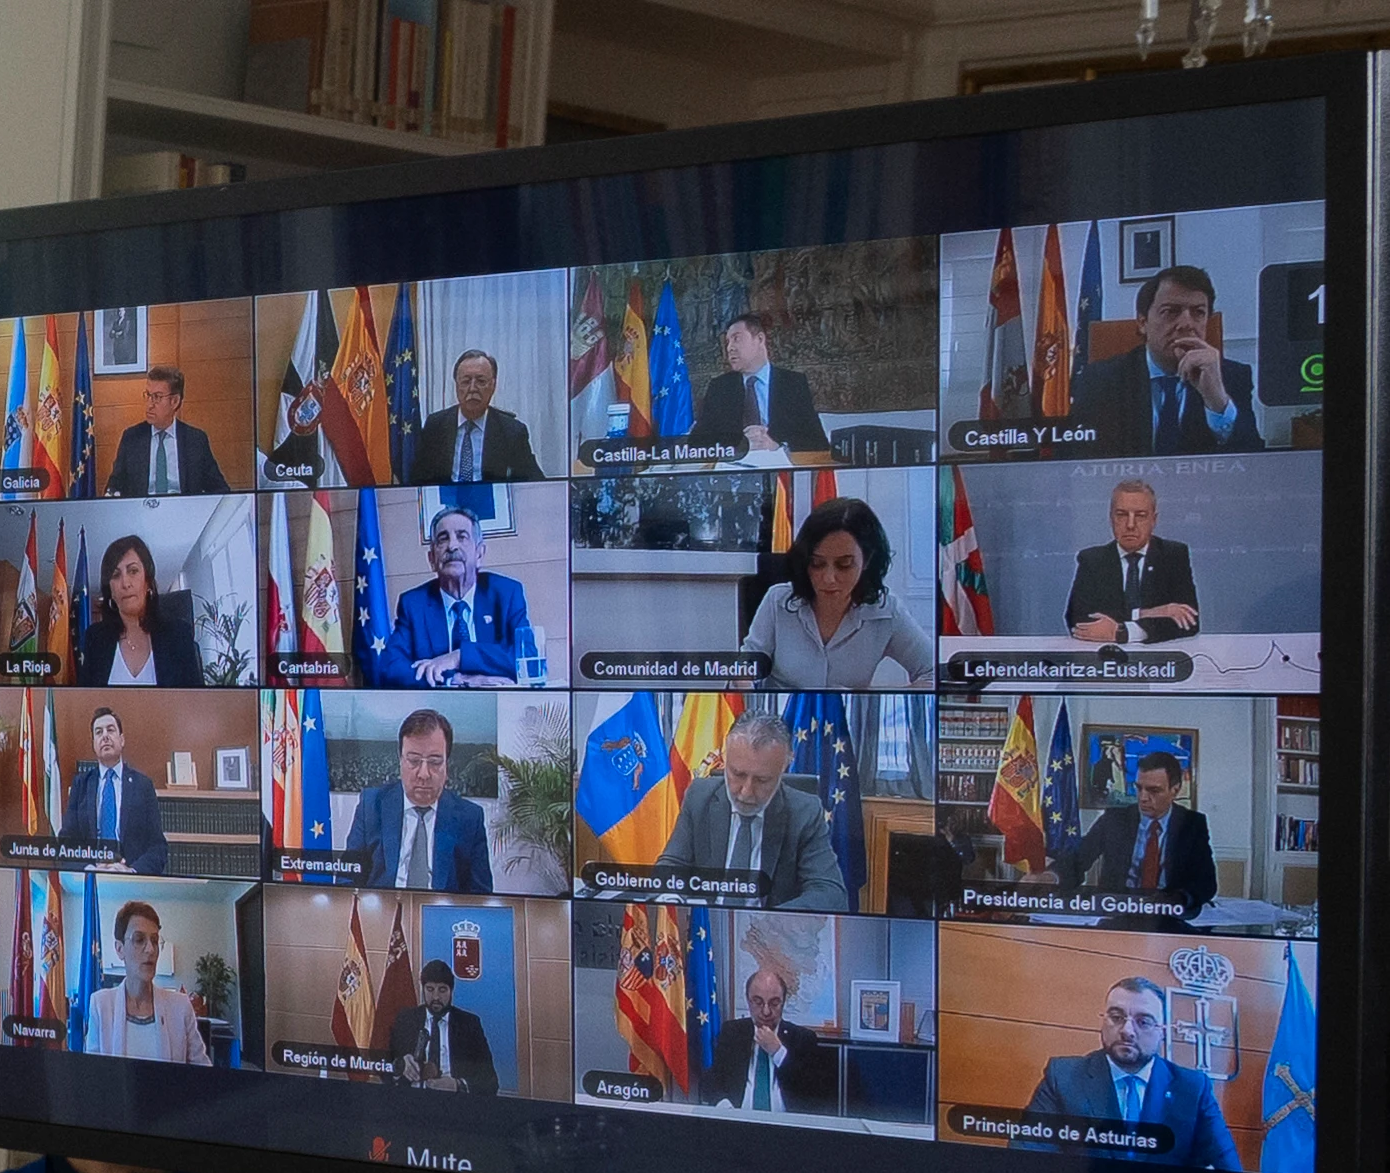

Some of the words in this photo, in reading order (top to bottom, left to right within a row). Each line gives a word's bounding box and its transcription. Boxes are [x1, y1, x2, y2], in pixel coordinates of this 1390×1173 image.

[964, 428, 1028, 447] Castilla
[1033, 428, 1046, 443] Y
[1051, 424, 1096, 442] León
[592, 445, 671, 464] Castilla-La
[674, 442, 735, 460] Mancha
[275, 462, 313, 478] Ceuta
[1070, 460, 1247, 478] AJURIA-ENEA
[2, 475, 40, 490] Galicia
[6, 660, 18, 673] La
[22, 659, 51, 675] Rioja
[278, 659, 339, 675] Cantabria
[594, 660, 677, 677] Comunidad
[682, 660, 701, 676] de
[705, 660, 758, 677] Madrid
[964, 660, 1176, 679] Lehendakaritza-Euskadi
[9, 842, 38, 858] Junta
[42, 844, 56, 858] de
[58, 844, 114, 861] Andalucía
[281, 855, 361, 874] Extremadura
[595, 871, 661, 889] Gobierno
[667, 873, 684, 890] de
[688, 875, 757, 894] Canarias
[963, 889, 1063, 910] Presidencia
[1068, 893, 1096, 912] del
[1101, 895, 1184, 916] Gobierno
[13, 1022, 56, 1040] Navarra
[283, 1048, 326, 1067] Región
[331, 1053, 346, 1068] de
[350, 1055, 394, 1074] Murcia
[597, 1079, 649, 1100] Aragón
[963, 1114, 1053, 1140] Principado
[1059, 1123, 1080, 1142] de
[1086, 1126, 1158, 1150] Asturias
[406, 1146, 473, 1172] Mute
